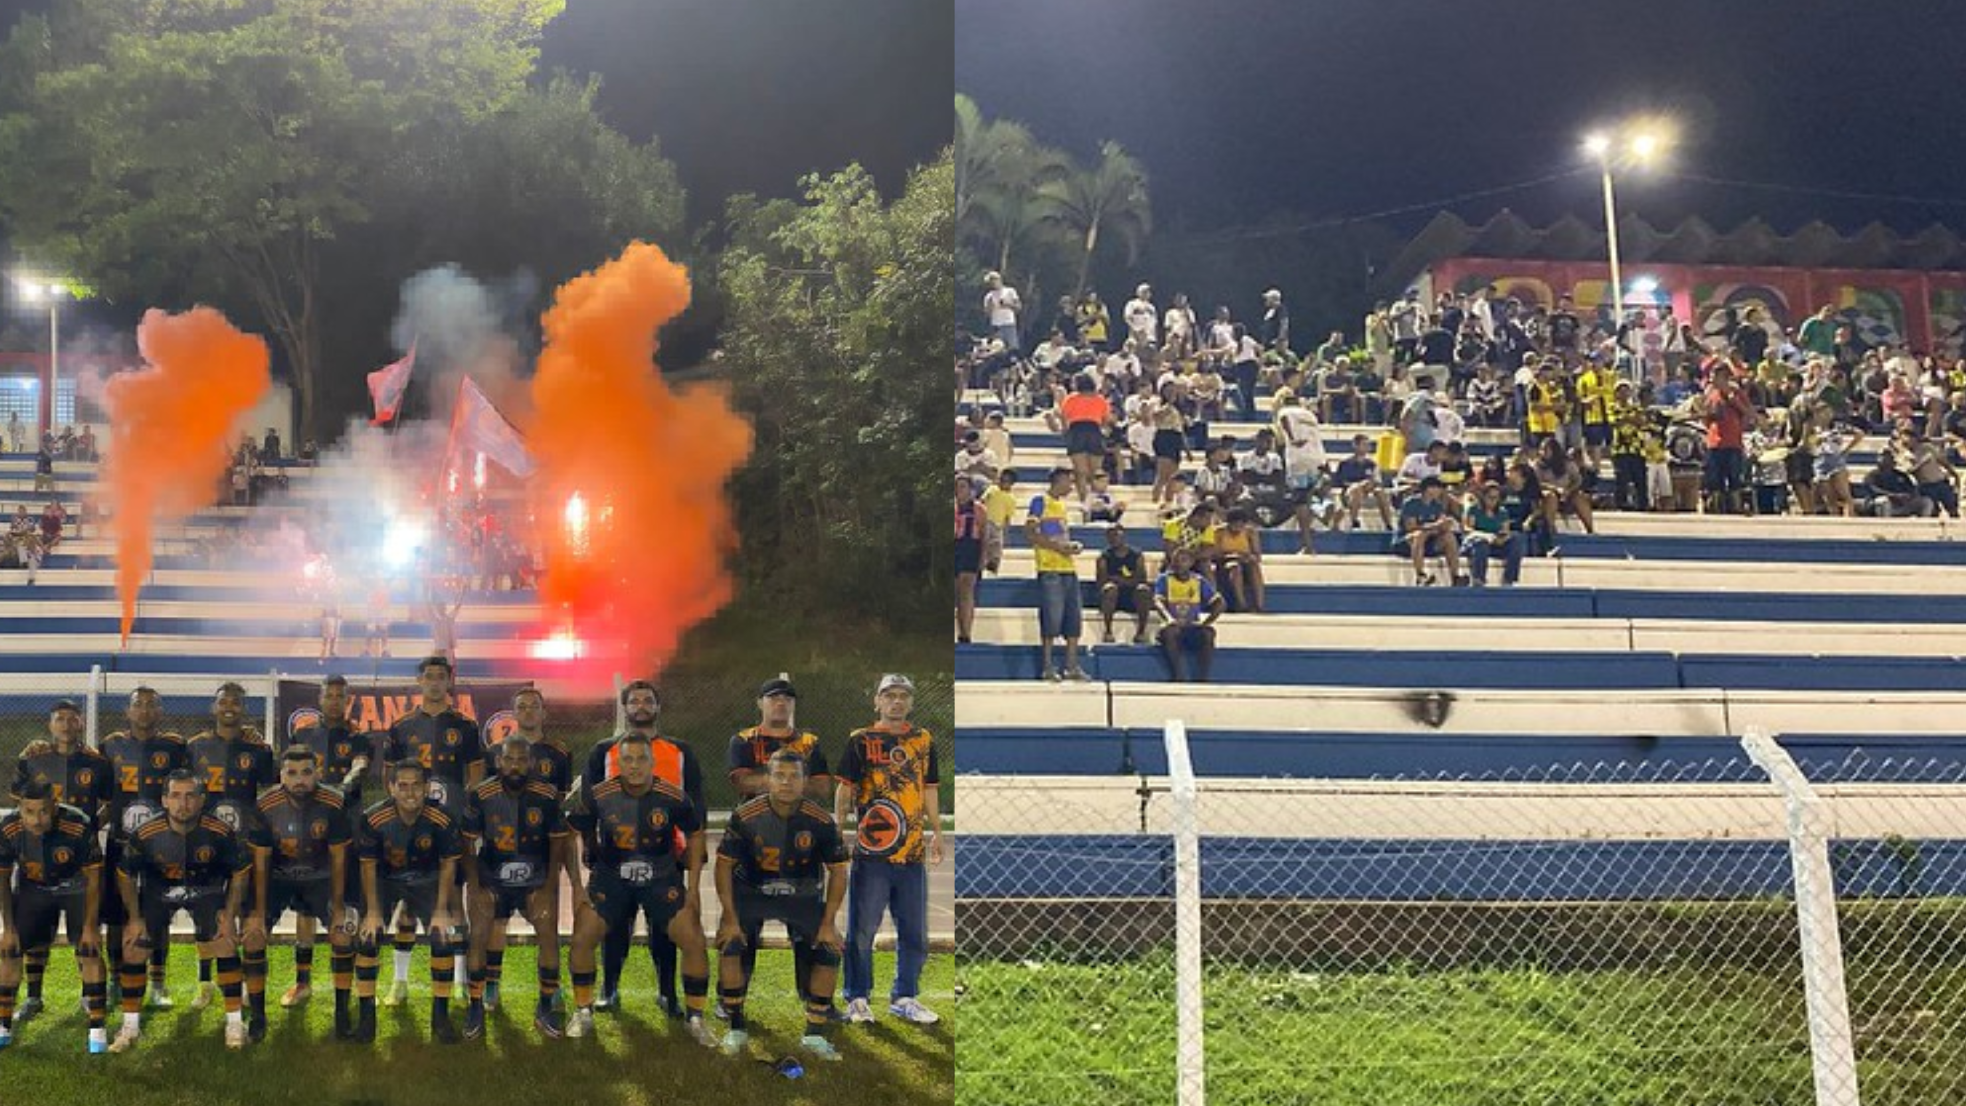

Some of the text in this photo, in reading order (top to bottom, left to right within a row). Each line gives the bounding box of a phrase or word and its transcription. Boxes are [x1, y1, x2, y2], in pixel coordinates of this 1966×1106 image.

[121, 765, 139, 792] Z
[207, 766, 225, 792] Z
[497, 825, 516, 851] Z
[616, 825, 637, 850] Z
[762, 846, 780, 872] Z
